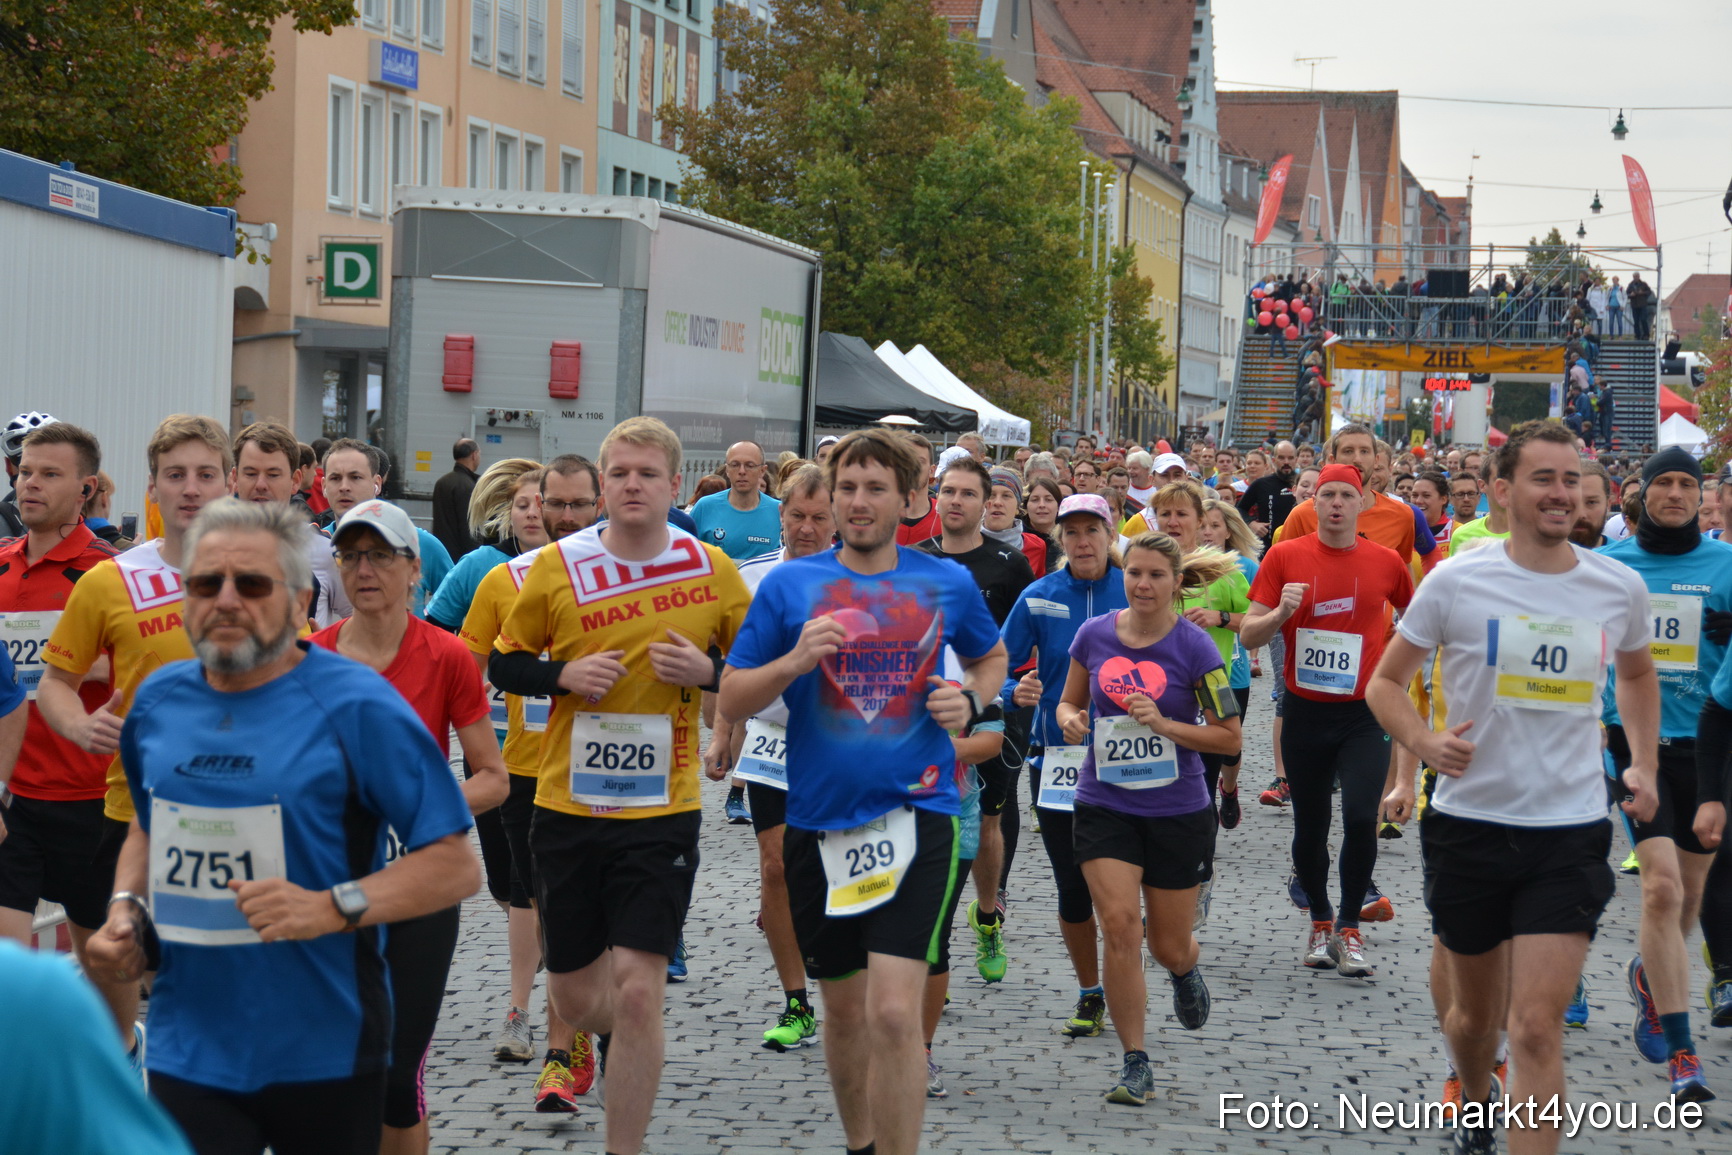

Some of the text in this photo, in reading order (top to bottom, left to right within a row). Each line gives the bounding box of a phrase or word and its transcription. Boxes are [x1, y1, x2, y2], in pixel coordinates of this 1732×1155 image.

[334, 251, 371, 290] D
[664, 309, 746, 353] OFFICE INDUSTRY LOUNGE
[759, 316, 803, 377] BOCK
[1423, 350, 1475, 368] ZIEL
[561, 410, 575, 419] NM
[585, 412, 604, 420] 1106
[1671, 583, 1712, 593] BOCK
[580, 585, 719, 633] MAX BÖGL
[1325, 602, 1343, 611] DEHN
[138, 611, 184, 638] MA
[1539, 623, 1573, 633] BOCK
[1654, 616, 1680, 640] 18
[860, 641, 898, 650] CHALLENGE
[835, 651, 918, 674] FINISHER
[1304, 648, 1350, 671] 2018
[1530, 644, 1568, 674] 40
[1314, 673, 1336, 683] Robert
[843, 684, 907, 697] RELAY TEAM
[1526, 681, 1567, 695] Michael
[863, 698, 888, 711] 2017
[608, 723, 642, 731] BOCK
[585, 741, 655, 771] 2626
[752, 735, 787, 760] 247
[1105, 736, 1163, 762] 2206
[188, 754, 255, 768] ERTEL
[758, 763, 784, 776] Werner
[1052, 766, 1083, 787] 29
[1121, 766, 1153, 777] Melanie
[602, 779, 636, 792] Jürgen
[188, 820, 235, 832] BOCK
[166, 845, 255, 890] 2751
[845, 839, 895, 878] 239
[857, 876, 890, 896] Manuel
